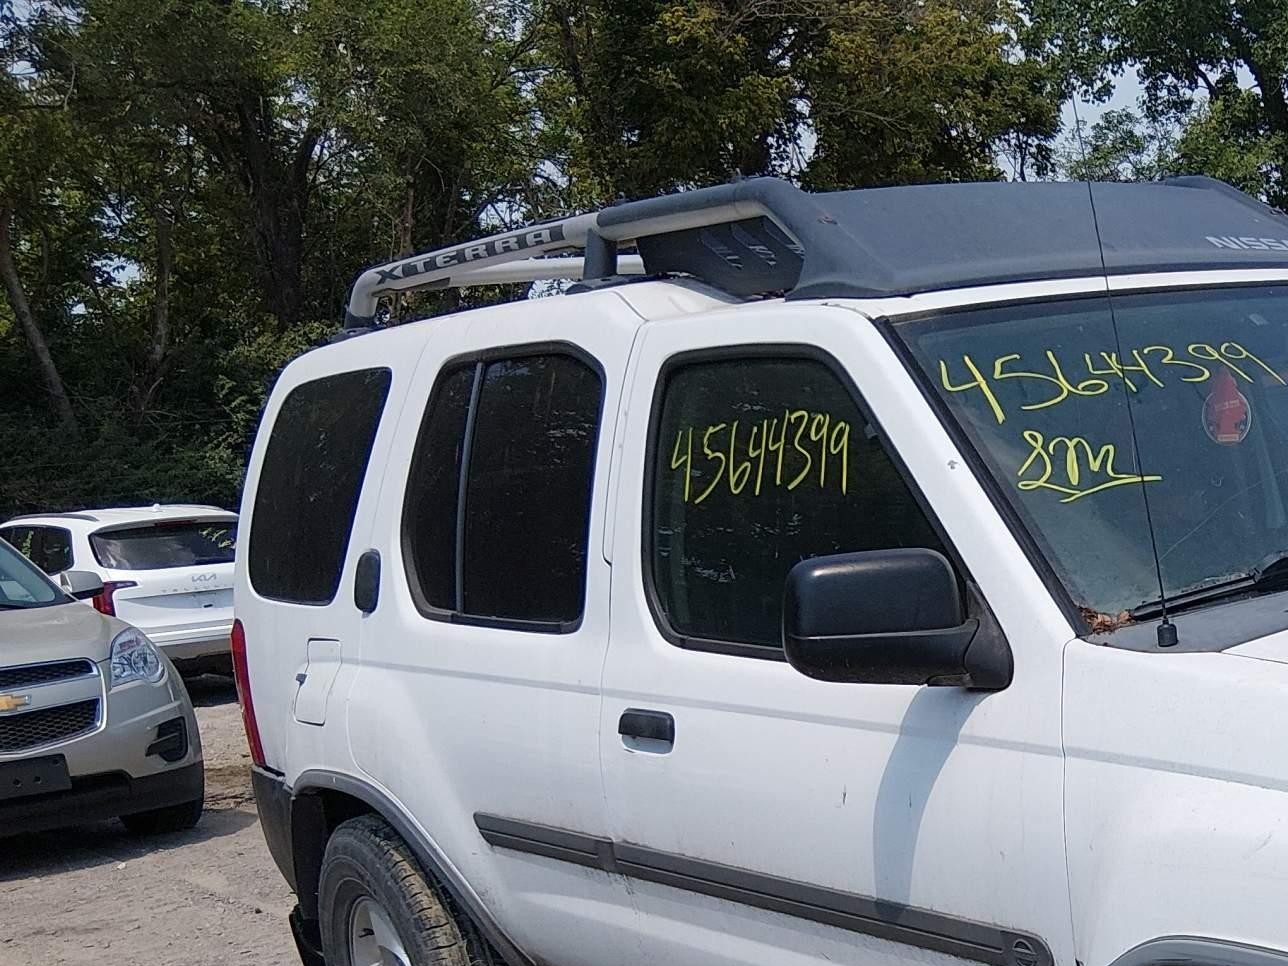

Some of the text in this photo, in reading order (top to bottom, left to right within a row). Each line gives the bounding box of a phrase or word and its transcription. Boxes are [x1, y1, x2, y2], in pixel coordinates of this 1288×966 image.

[375, 229, 552, 285] XTERRA
[939, 342, 1288, 424] 45644399
[671, 409, 850, 504] 45644399
